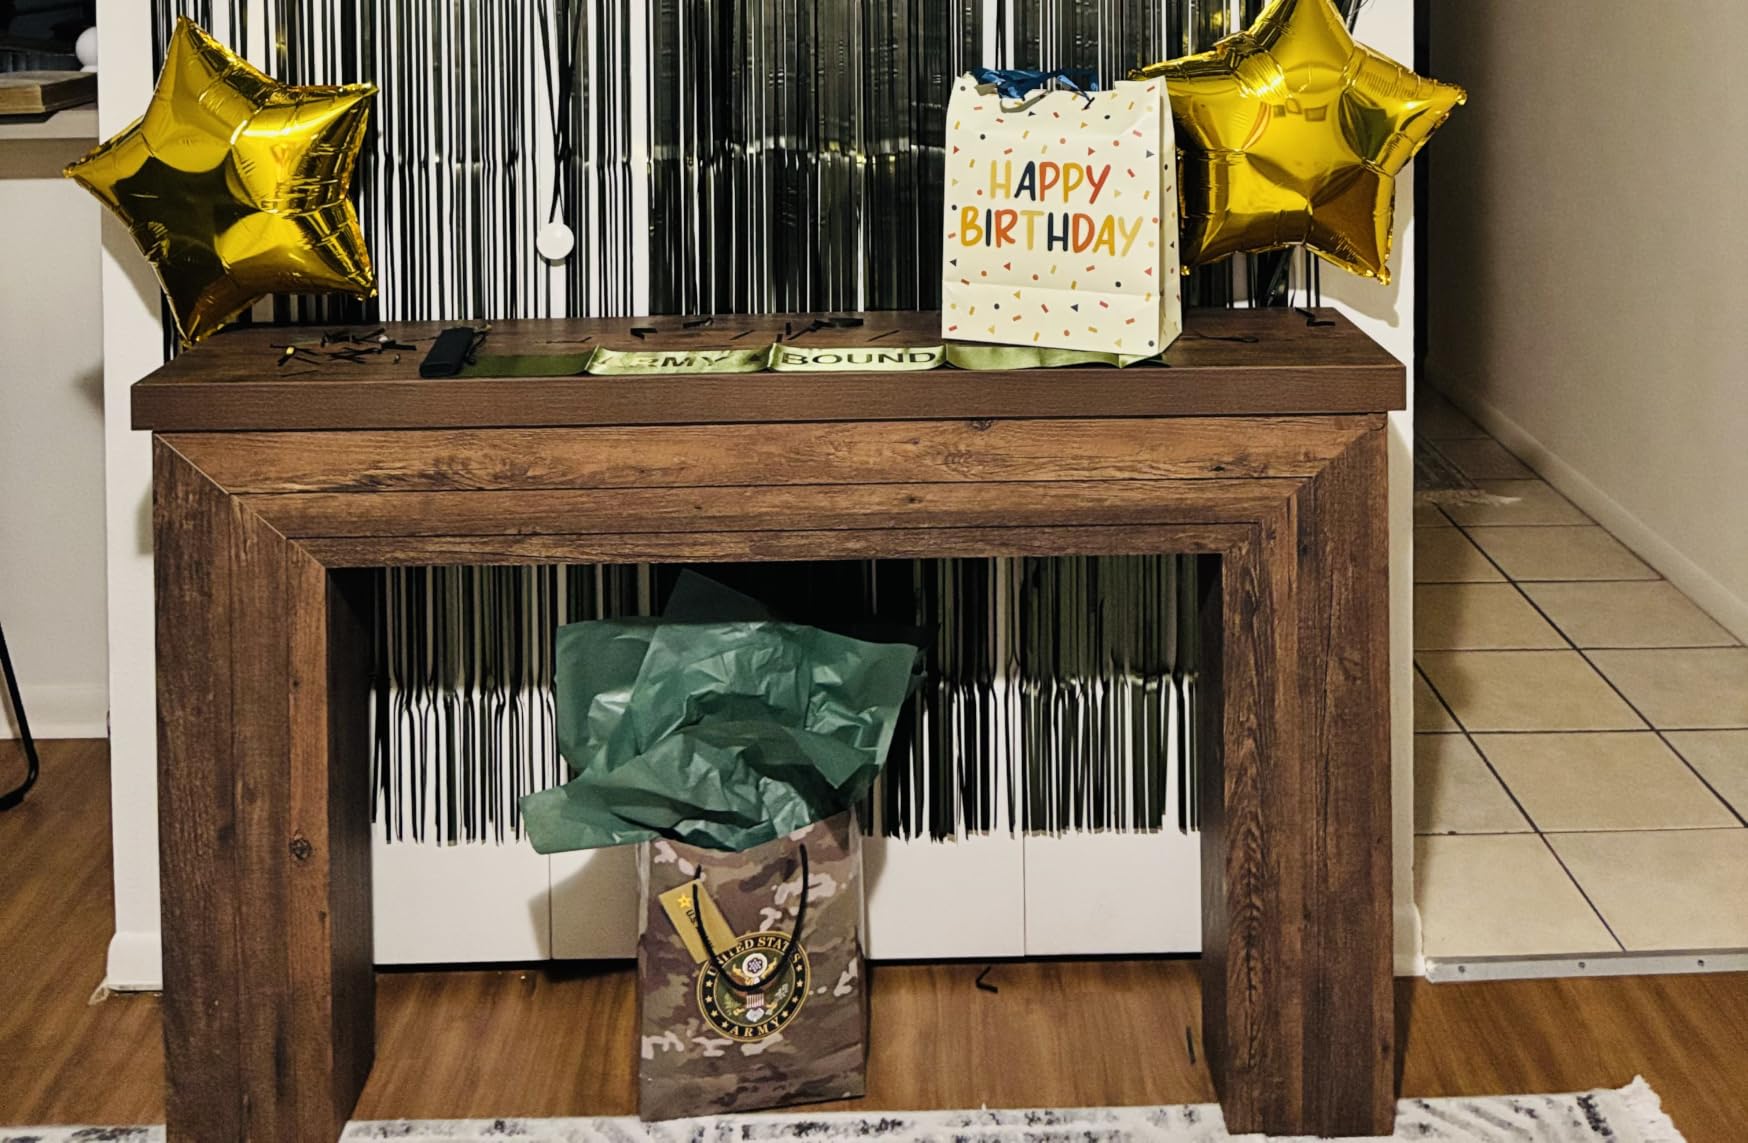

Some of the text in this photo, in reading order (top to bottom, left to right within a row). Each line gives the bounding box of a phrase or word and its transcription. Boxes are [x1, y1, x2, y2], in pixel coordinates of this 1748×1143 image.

[989, 160, 1111, 204] HAPPY
[960, 206, 1143, 257] BIRTHDAY
[781, 352, 936, 365] BOUND
[757, 936, 802, 964] STATS
[730, 1016, 780, 1036] ARMY
